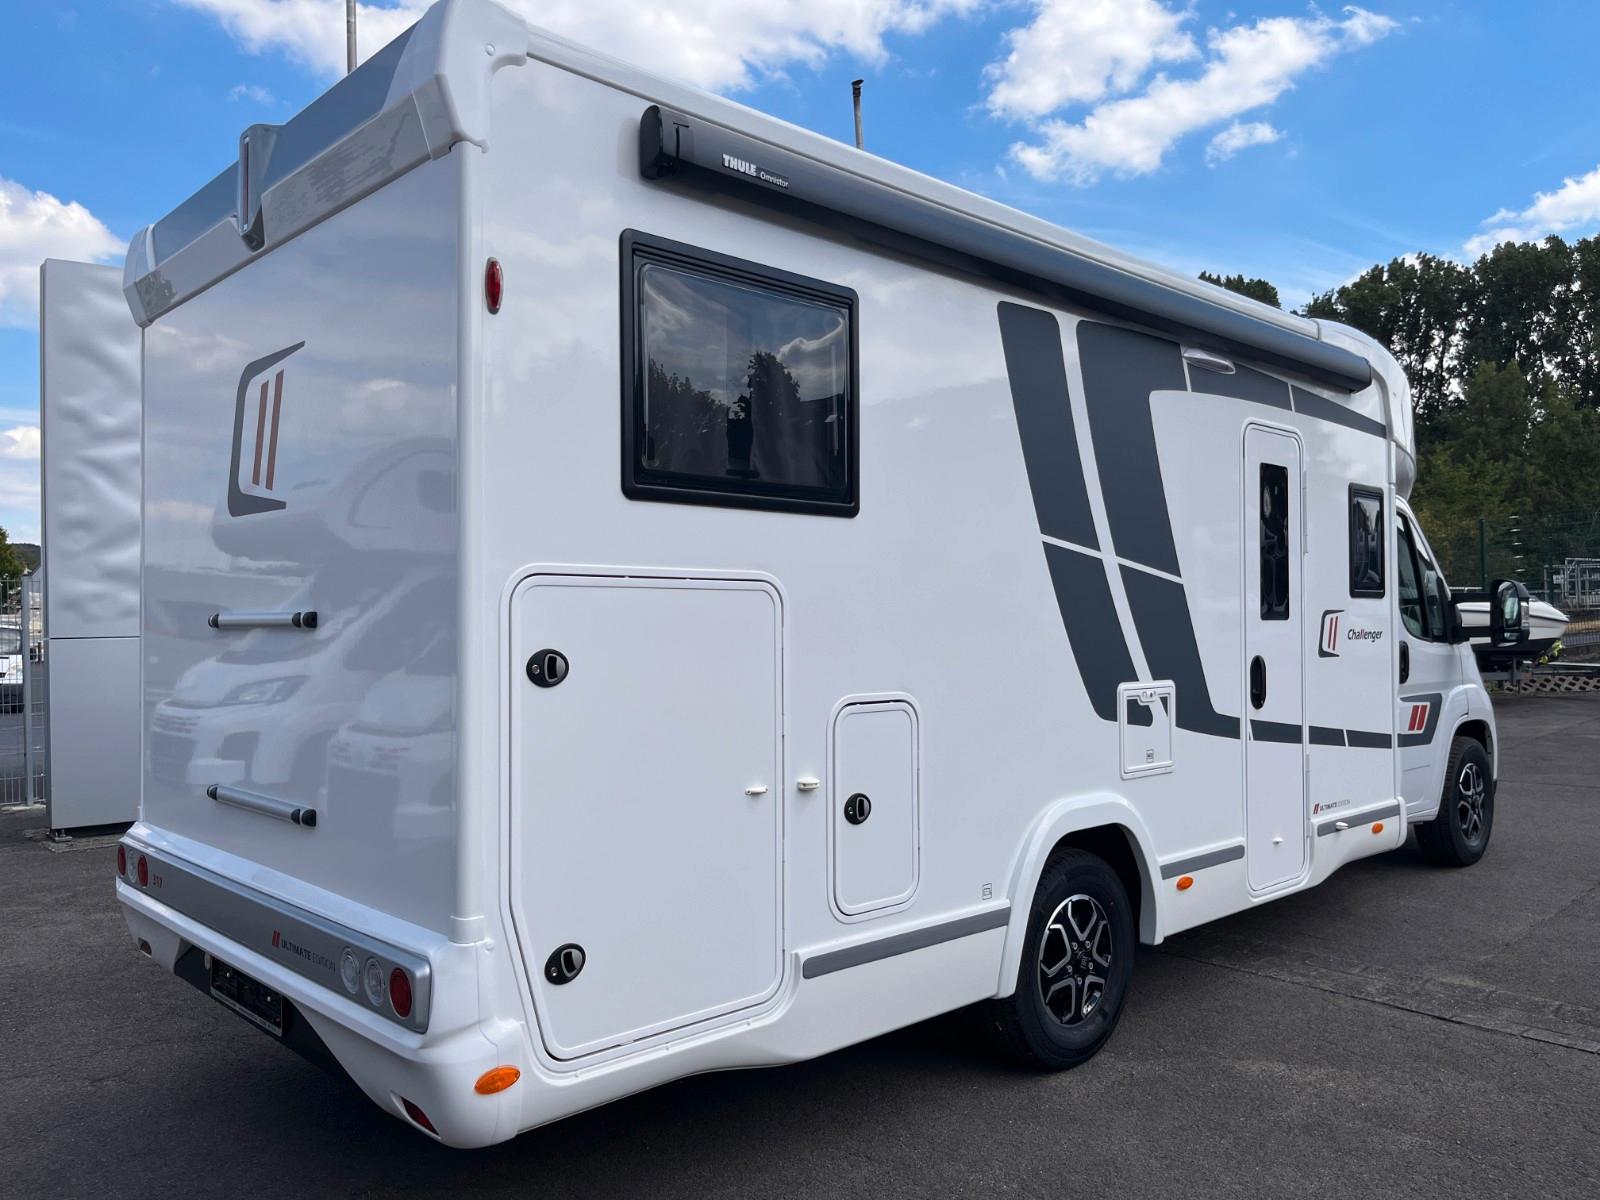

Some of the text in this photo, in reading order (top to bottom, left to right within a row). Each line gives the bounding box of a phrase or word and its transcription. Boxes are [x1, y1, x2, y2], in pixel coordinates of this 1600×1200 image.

[722, 153, 789, 188] THULE Omnistor
[1347, 628, 1383, 643] Challenger
[281, 938, 336, 973] ULTIMATE EDITION
